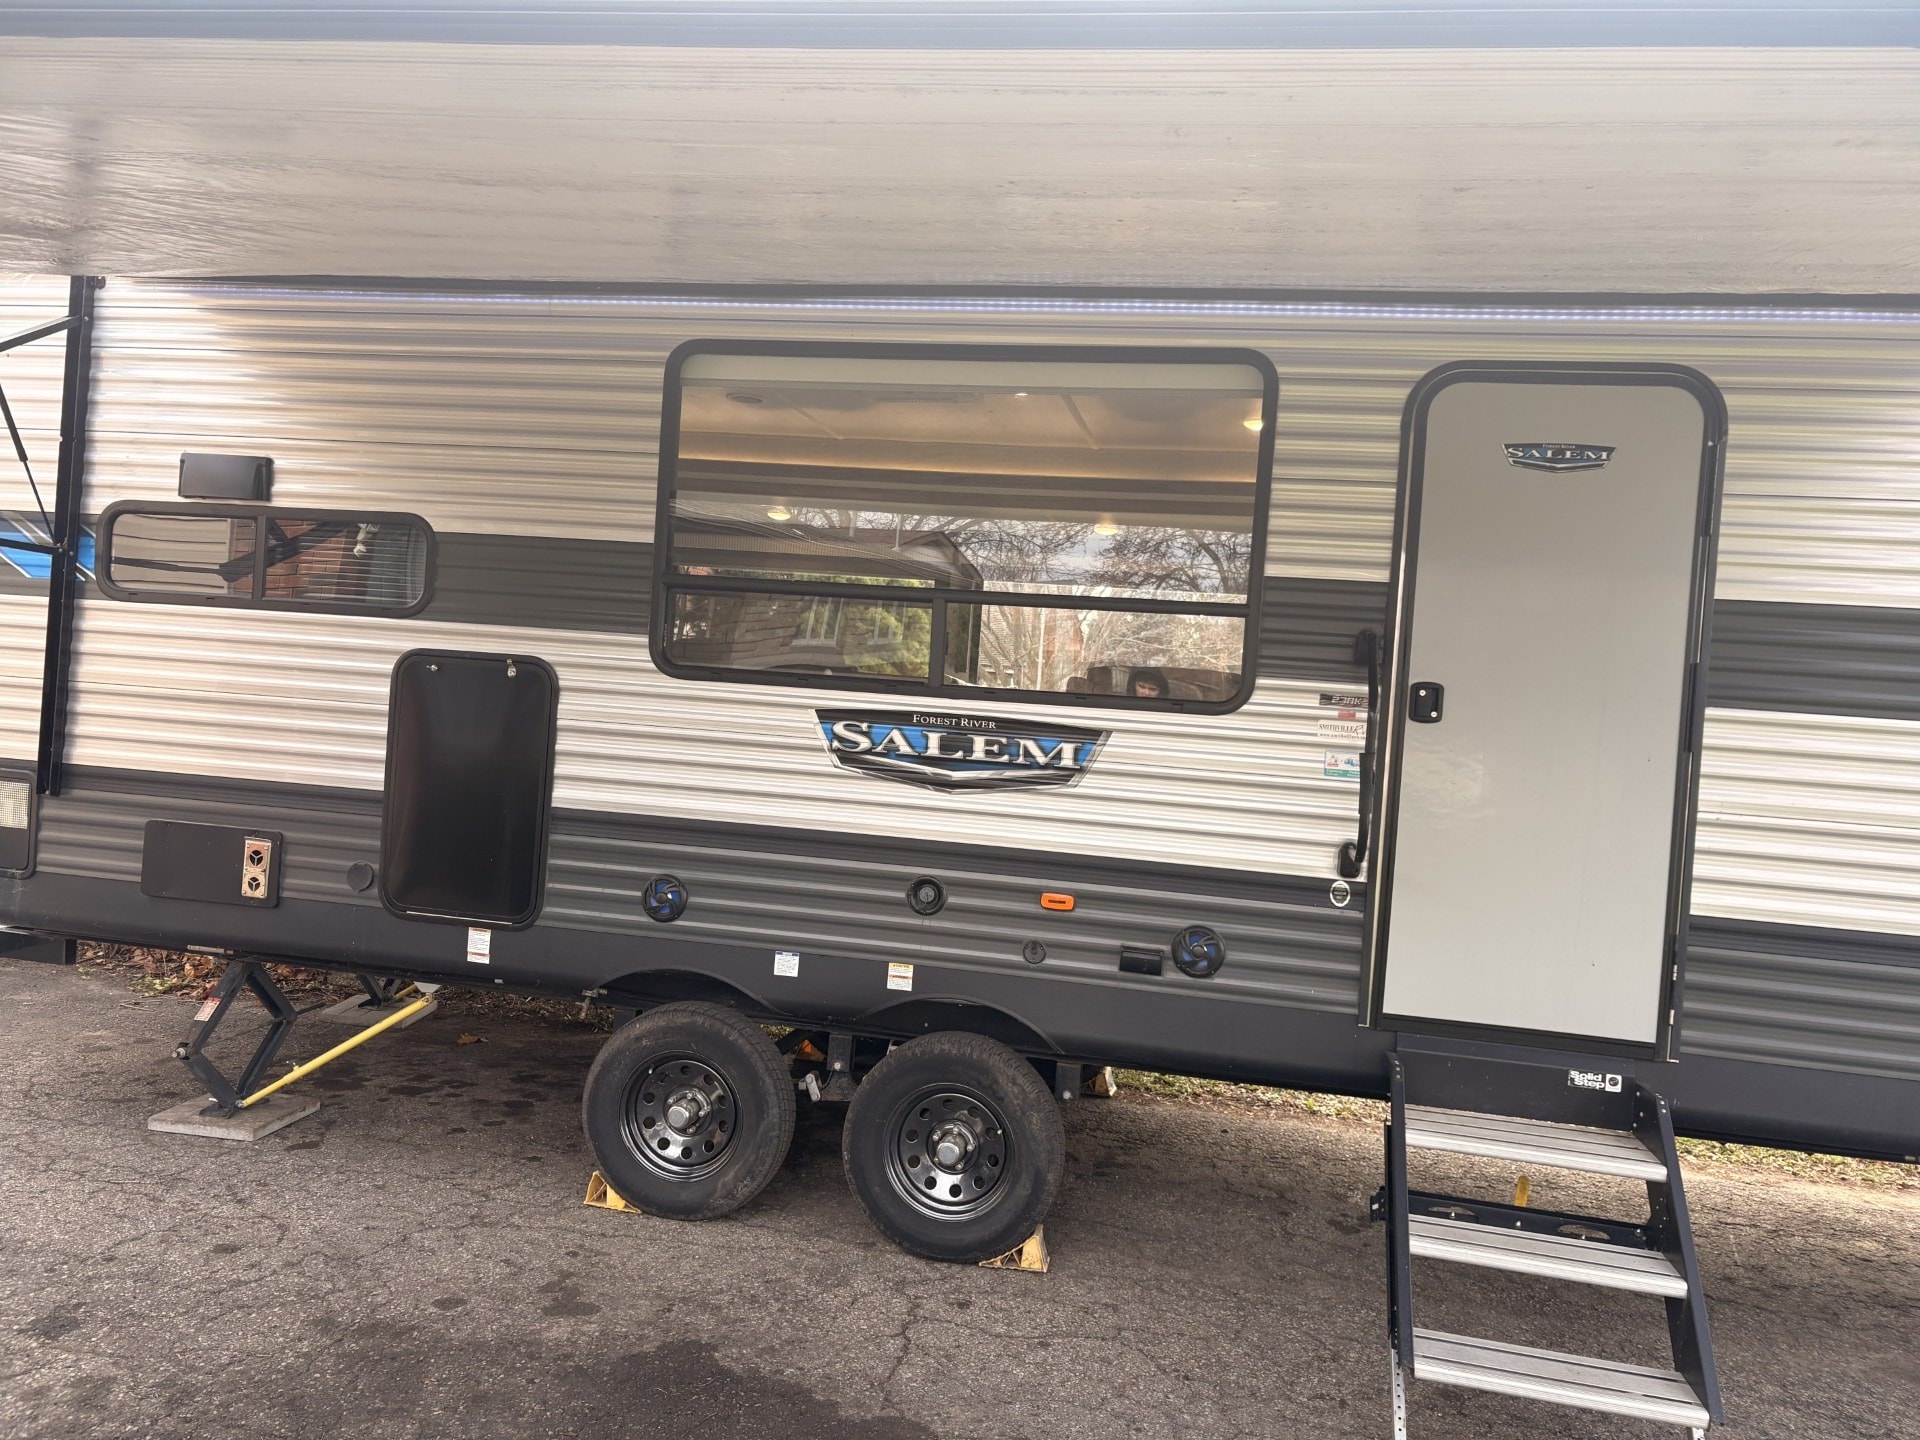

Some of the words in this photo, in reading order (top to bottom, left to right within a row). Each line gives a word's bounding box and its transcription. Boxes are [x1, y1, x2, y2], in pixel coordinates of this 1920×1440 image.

[1507, 447, 1610, 460] SALEM
[912, 714, 957, 726] FOREST
[960, 717, 997, 729] RIVER
[831, 720, 1081, 768] SALEM
[1570, 1070, 1603, 1082] Solid
[1573, 1078, 1605, 1090] Step
